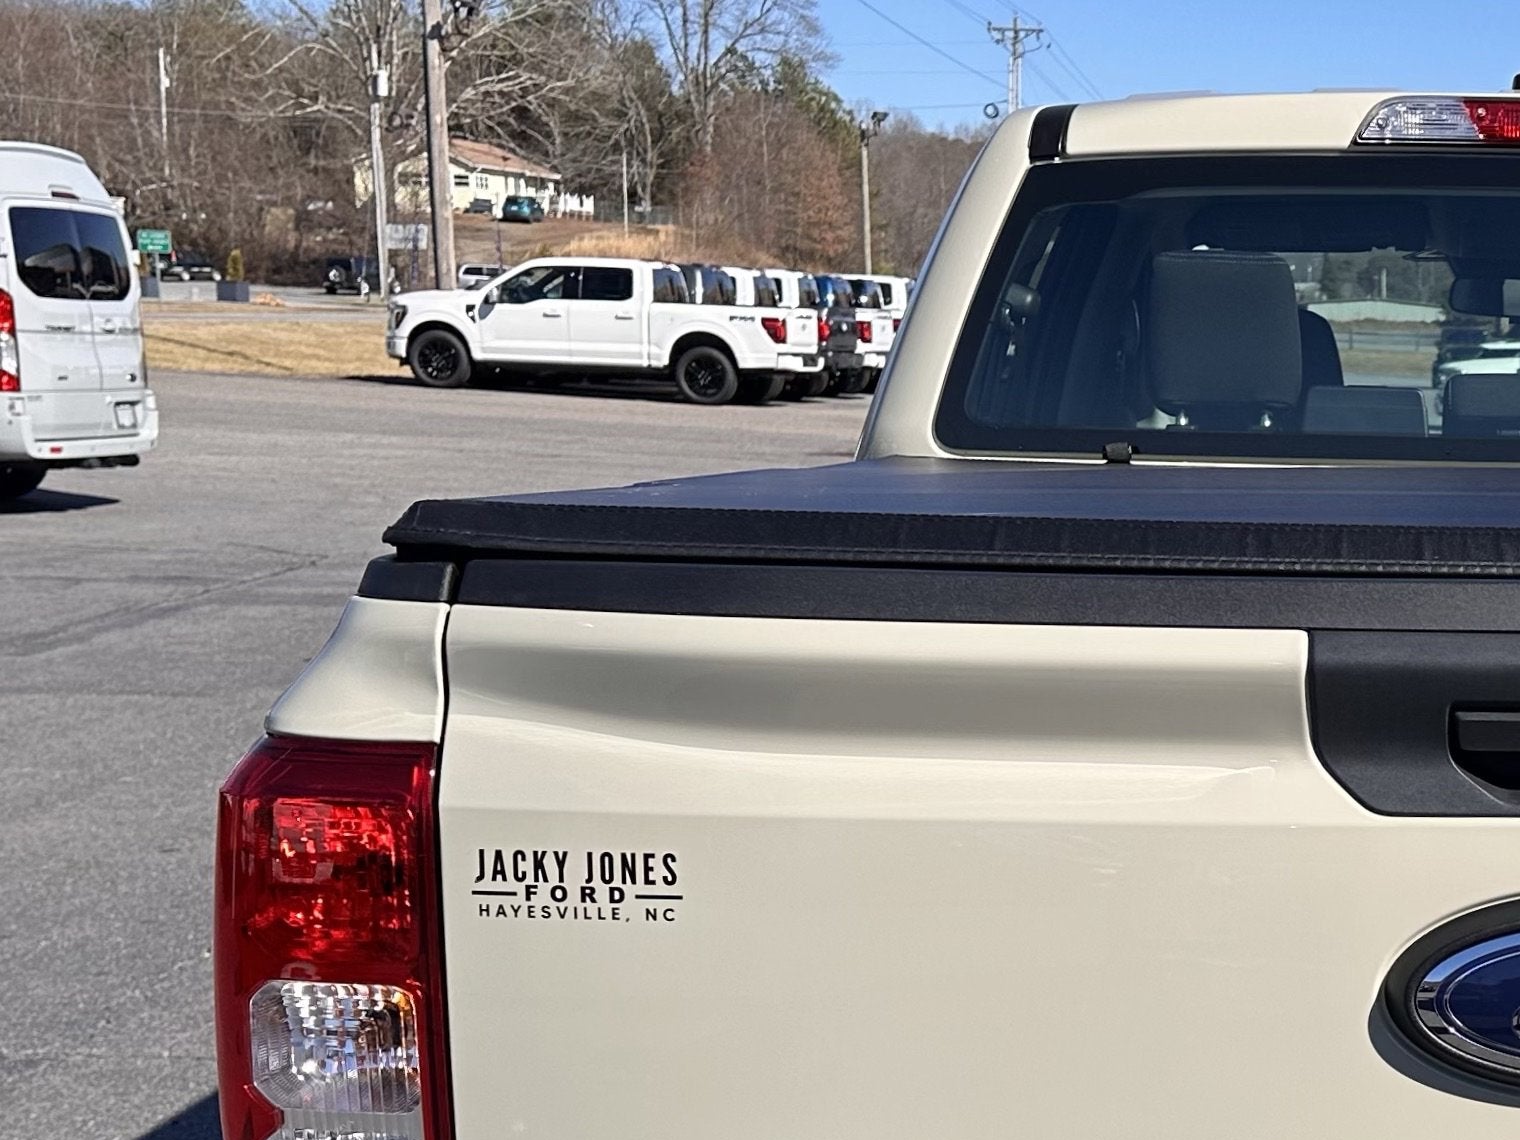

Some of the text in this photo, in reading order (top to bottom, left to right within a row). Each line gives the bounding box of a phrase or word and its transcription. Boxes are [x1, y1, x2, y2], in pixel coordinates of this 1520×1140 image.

[474, 848, 678, 886] JACKY JONES
[524, 884, 626, 904] FORD
[478, 903, 676, 923] HAYESVILLE, NC
